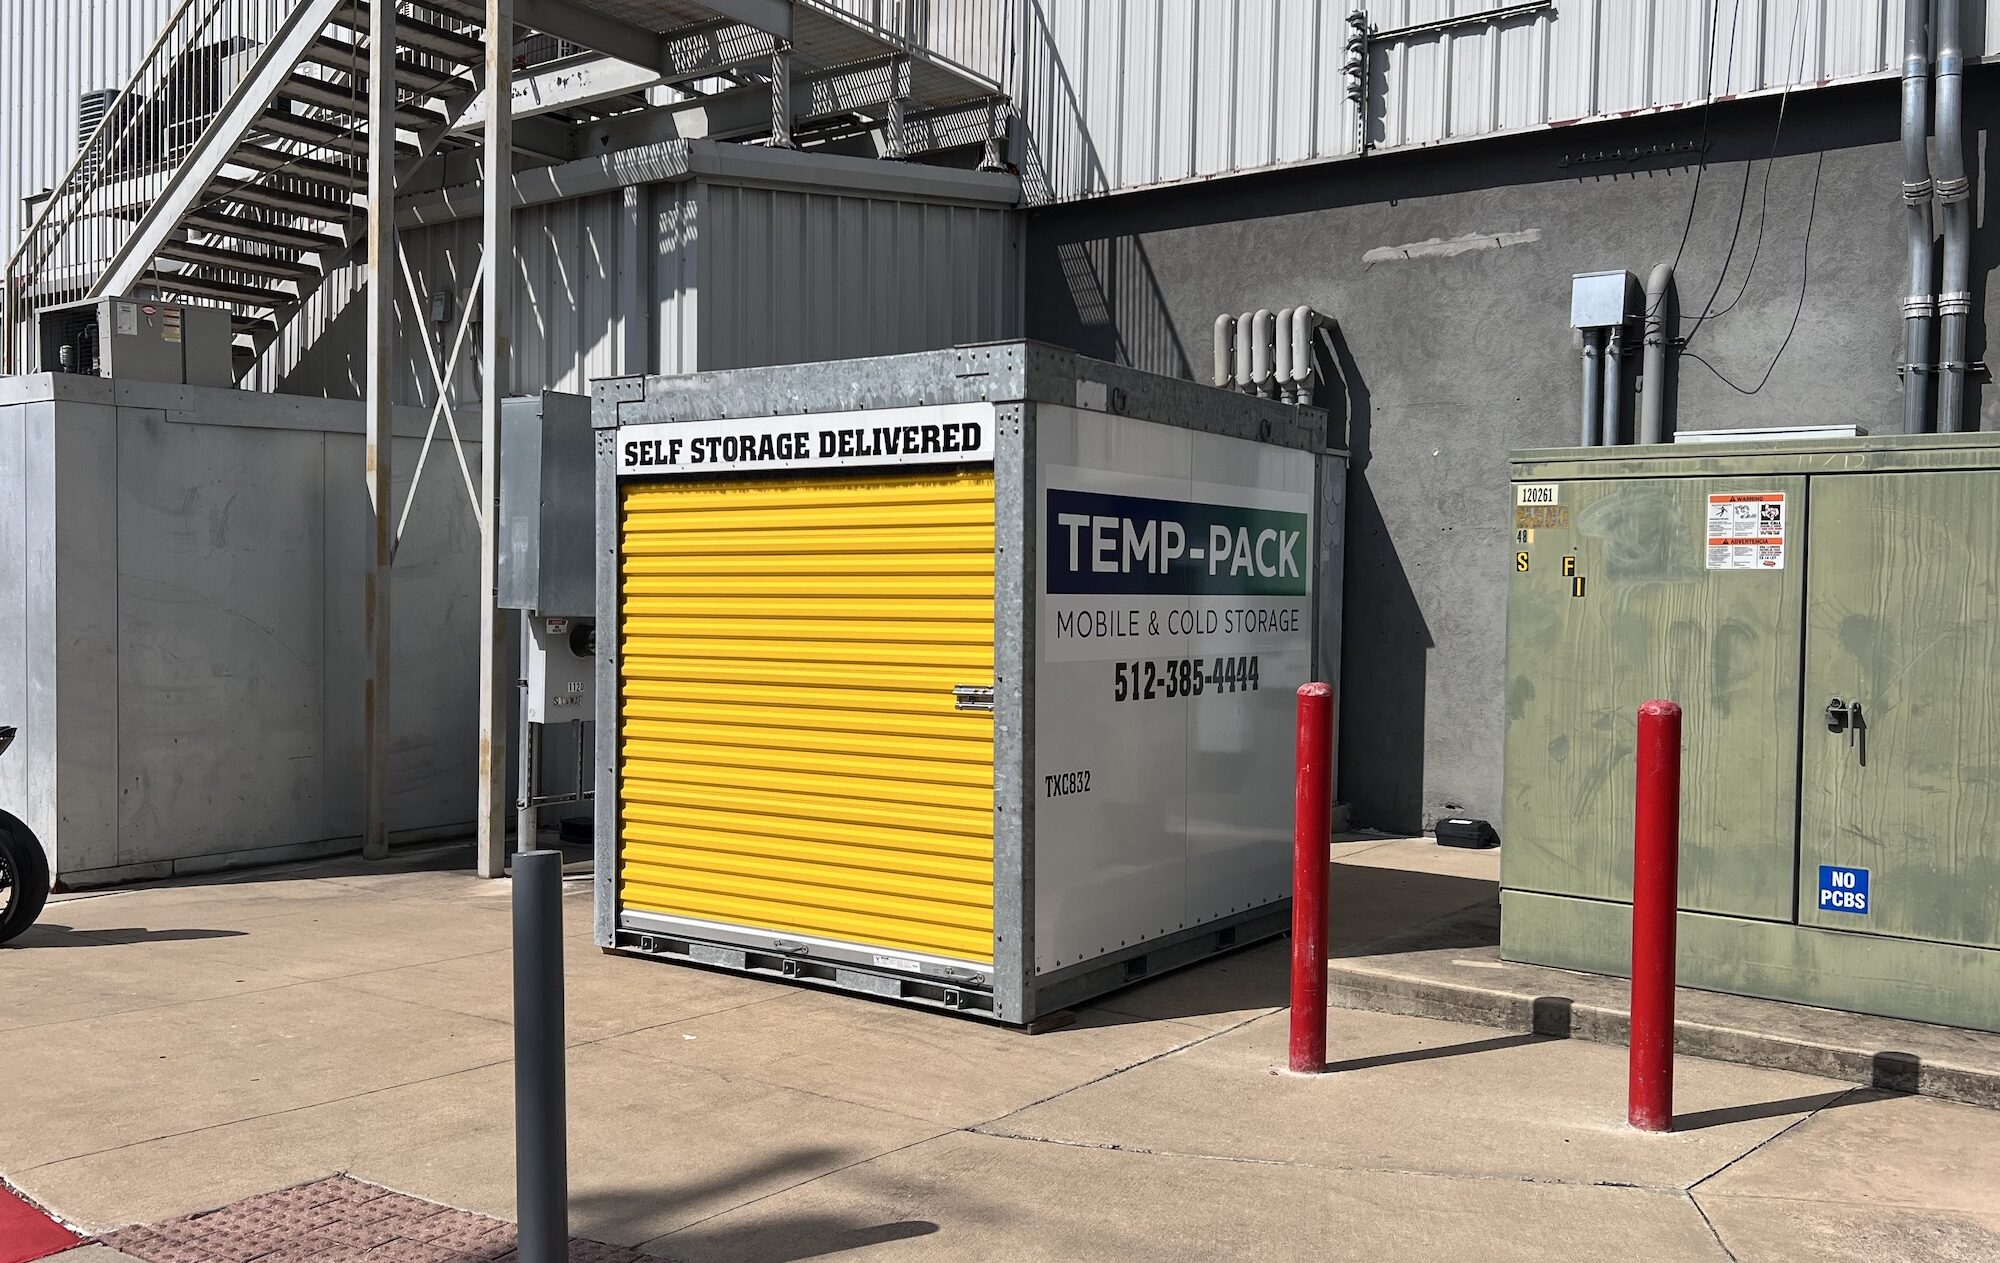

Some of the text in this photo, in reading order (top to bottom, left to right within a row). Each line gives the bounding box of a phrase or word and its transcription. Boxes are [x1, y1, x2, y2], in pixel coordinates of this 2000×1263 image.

[625, 422, 981, 467] SELF STORAGE DELIVERED
[1522, 487, 1553, 503] 120261
[1058, 512, 1300, 578] TEMP-PACK
[1517, 552, 1528, 572] S
[1564, 557, 1575, 577] F
[1056, 608, 1300, 639] MOBILE & COLD STORAGE
[1115, 656, 1259, 702] 512-385-4444
[1045, 770, 1091, 798] TXC832
[1832, 871, 1856, 889] NO
[1820, 889, 1866, 910] PCBS
